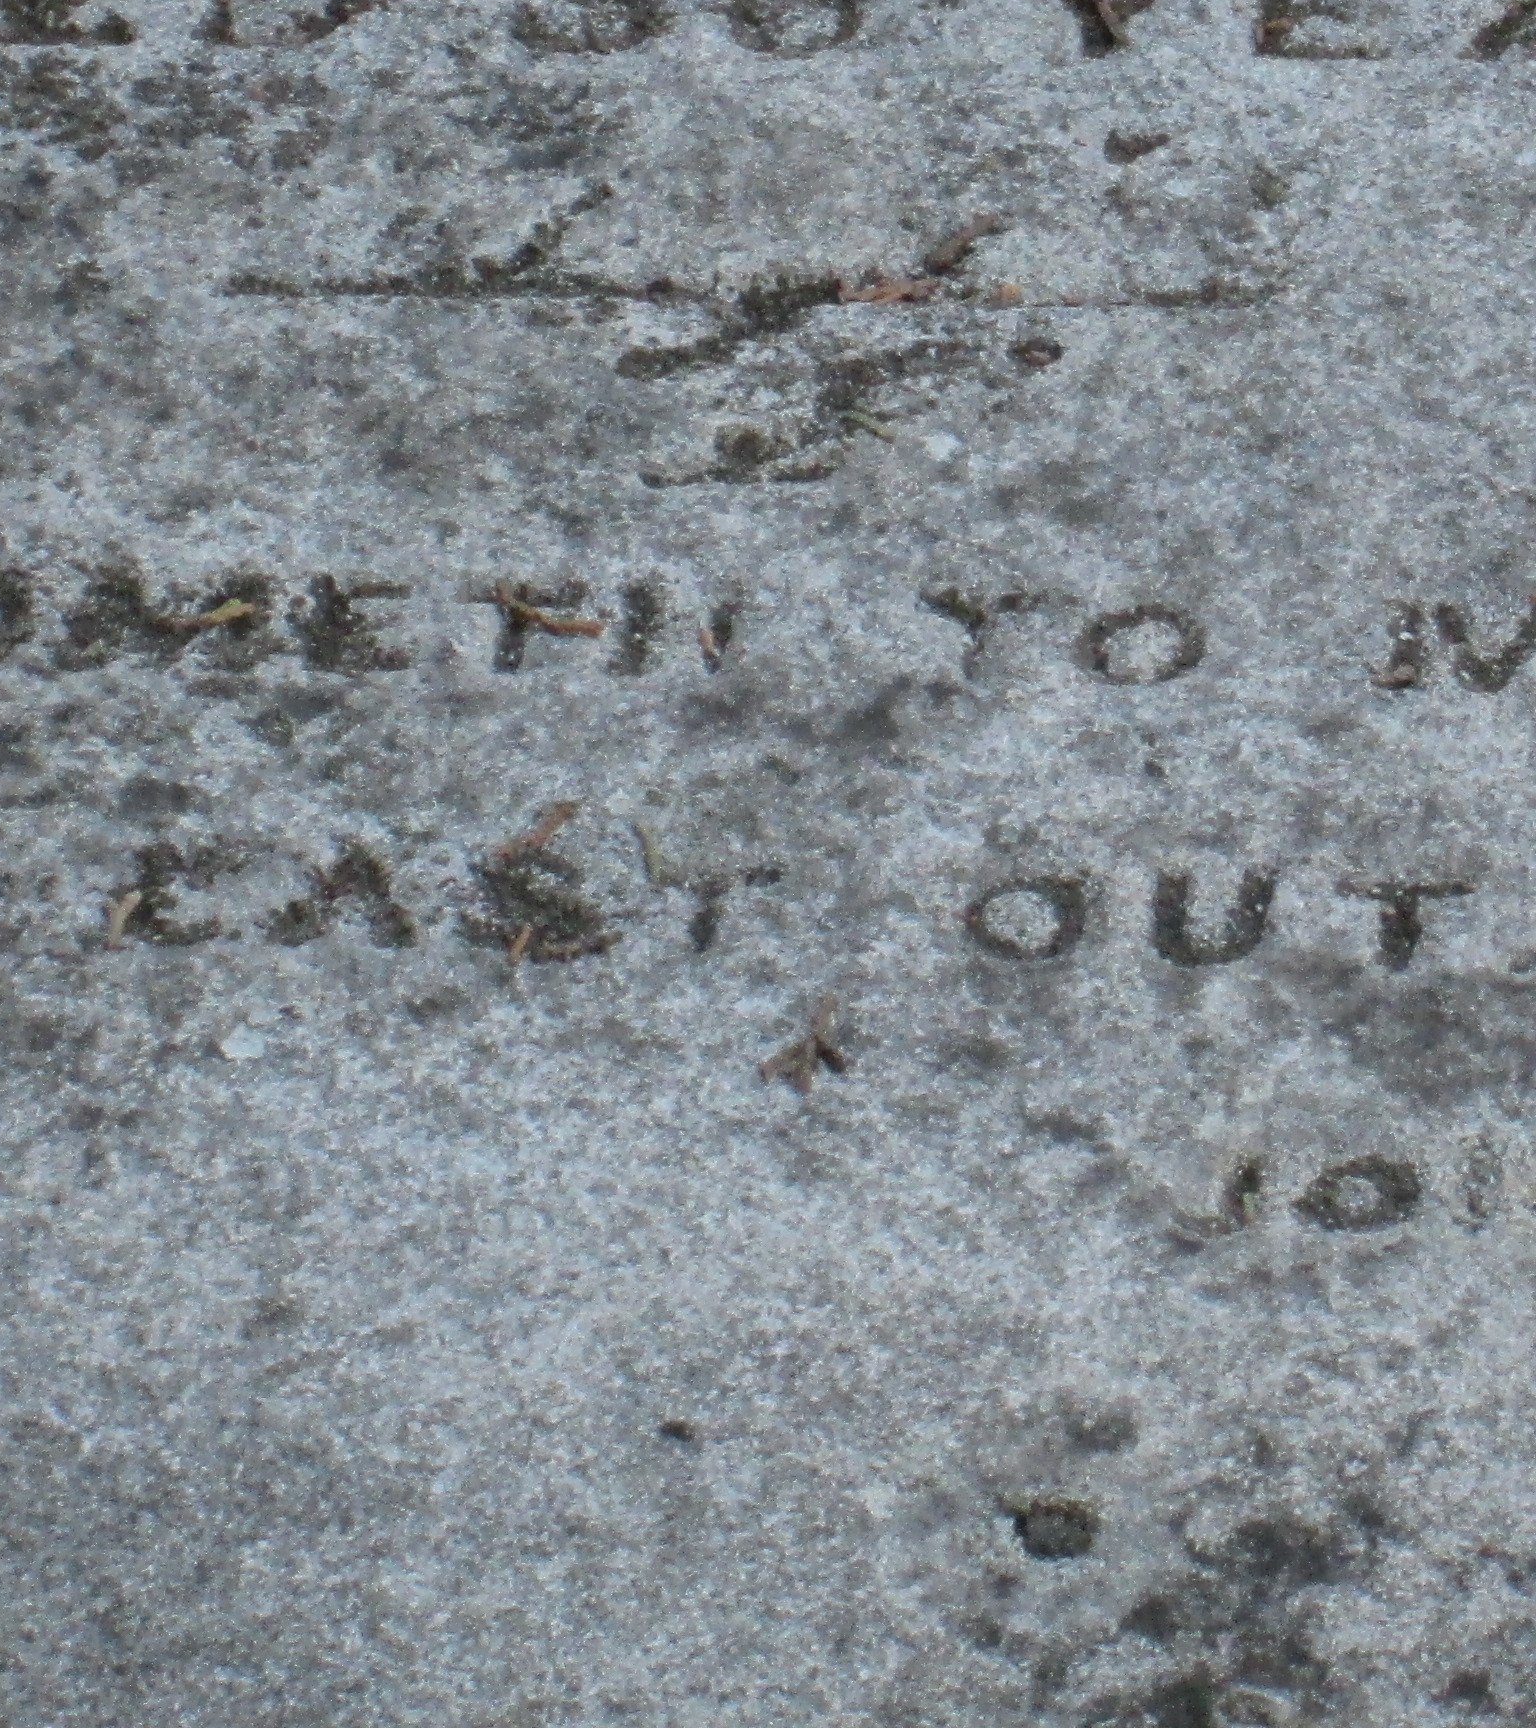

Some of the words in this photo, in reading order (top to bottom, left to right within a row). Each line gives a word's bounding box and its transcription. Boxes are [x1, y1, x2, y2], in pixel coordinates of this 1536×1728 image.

[919, 582, 1209, 687] TO
[104, 832, 789, 962] CAST
[964, 867, 1479, 972] OUT
